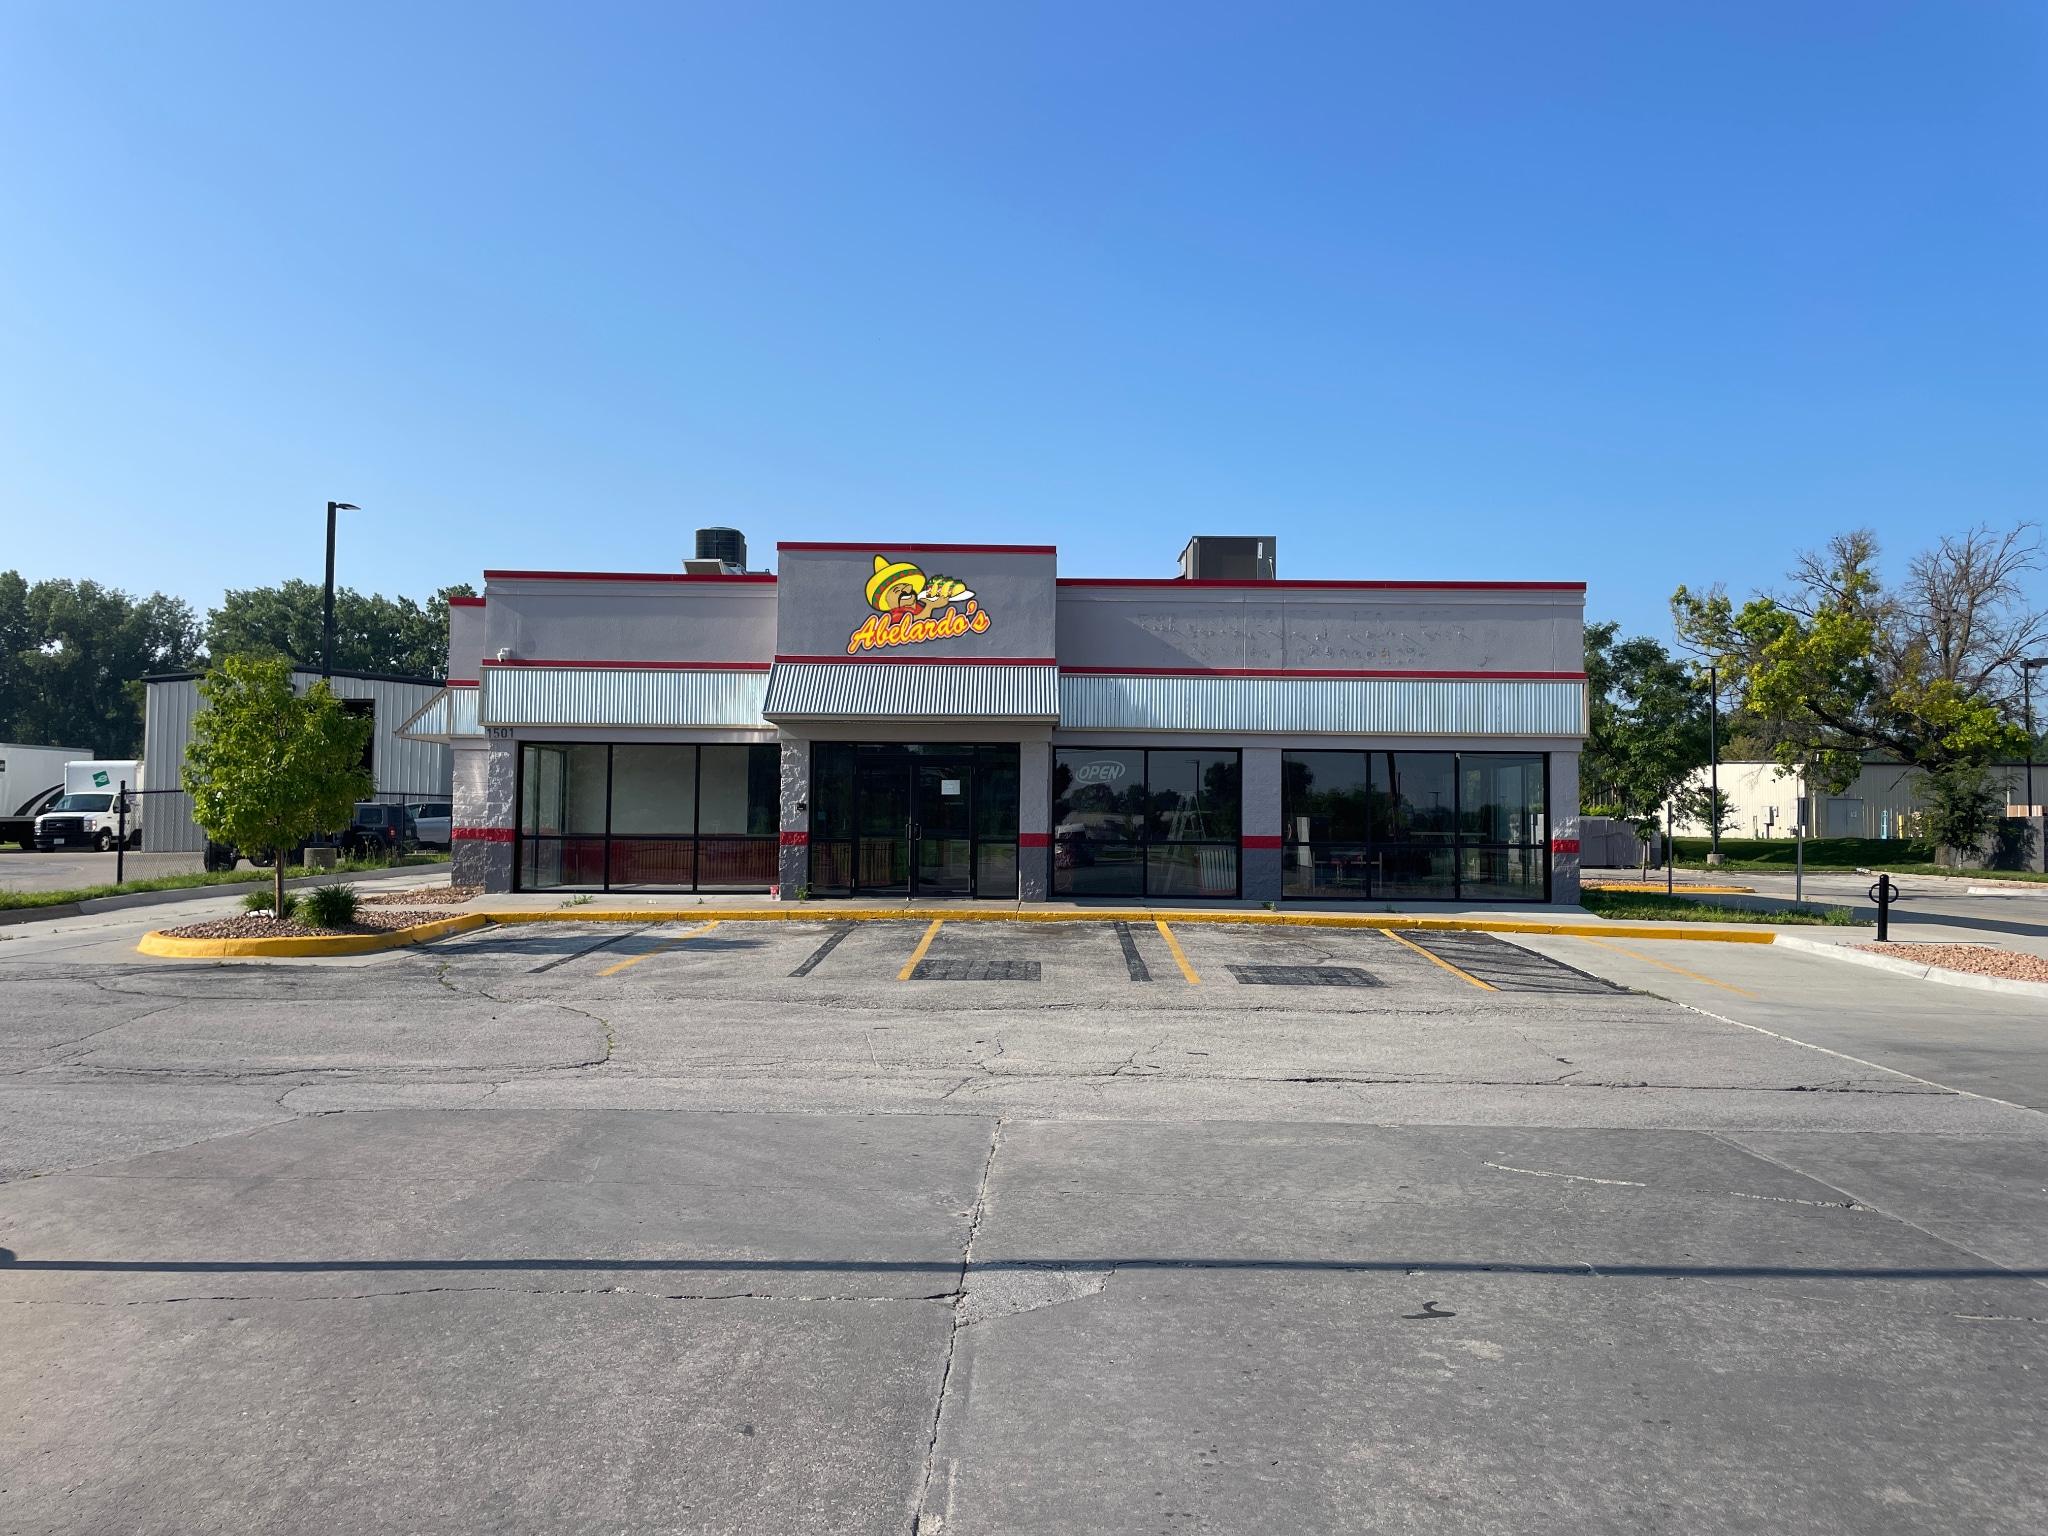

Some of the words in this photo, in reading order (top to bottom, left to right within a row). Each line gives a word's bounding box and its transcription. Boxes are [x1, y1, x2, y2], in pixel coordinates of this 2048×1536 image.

[846, 599, 992, 655] Abelardo's
[487, 728, 514, 738] 1501
[1078, 765, 1120, 780] OPEN
